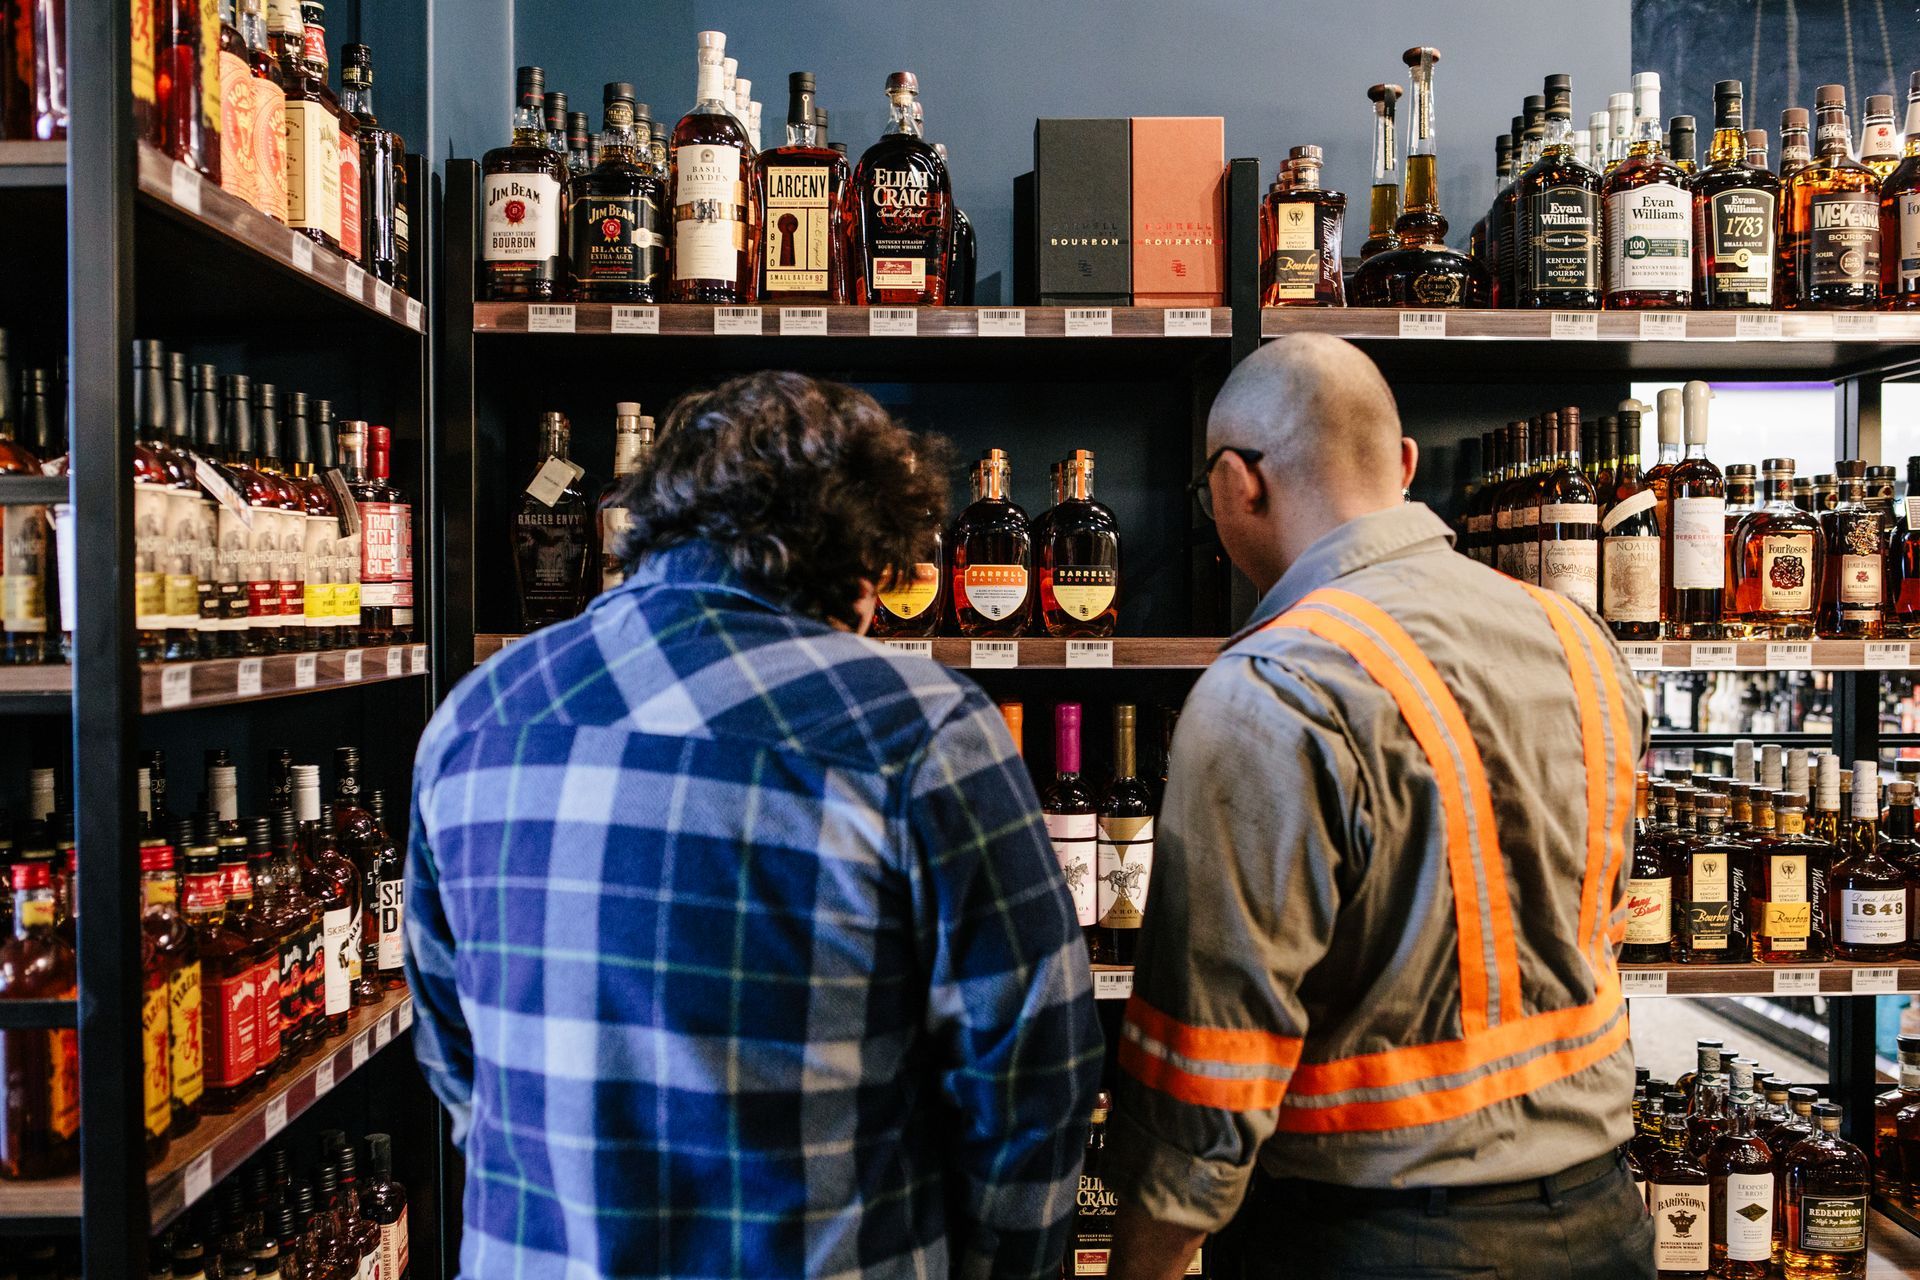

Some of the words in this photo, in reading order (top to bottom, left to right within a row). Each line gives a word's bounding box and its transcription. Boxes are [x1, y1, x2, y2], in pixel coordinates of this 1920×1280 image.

[692, 165, 722, 173] BASIL
[686, 175, 729, 183] HAYDEN
[874, 168, 929, 190] ELIJAH
[769, 174, 827, 198] LARCENY
[489, 187, 509, 206] JIM
[511, 182, 541, 205] BEAM
[873, 186, 928, 208] CRAIG
[1731, 195, 1756, 204] Evan
[1642, 196, 1674, 207] Evan
[589, 207, 607, 225] JIM
[609, 203, 636, 225] BEAM
[1550, 203, 1582, 214] Evan
[1724, 203, 1764, 214] Williams
[1540, 214, 1593, 225] Williams
[1632, 209, 1685, 220] Williams
[1723, 216, 1764, 238] 1783
[1051, 238, 1119, 246] BOURBON
[1145, 238, 1213, 246] BOURBON
[1828, 233, 1873, 241] BOURBON
[492, 237, 536, 249] BOURBON
[1629, 240, 1646, 249] 100
[1278, 253, 1318, 271] Bourbon
[815, 274, 823, 282] 92
[556, 514, 580, 525] ENVY
[366, 530, 390, 545] CITY
[1768, 544, 1785, 554] Four
[1785, 544, 1808, 554] Roses
[1691, 904, 1730, 923] Bourbon
[1852, 902, 1903, 916] 1843
[1768, 906, 1808, 924] Bourbon
[1658, 1197, 1706, 1212] BARDSTOWN
[1808, 1208, 1861, 1217] REDEMPTION
[382, 1229, 392, 1252] MAPLE
[382, 1252, 392, 1280] SMOKED
